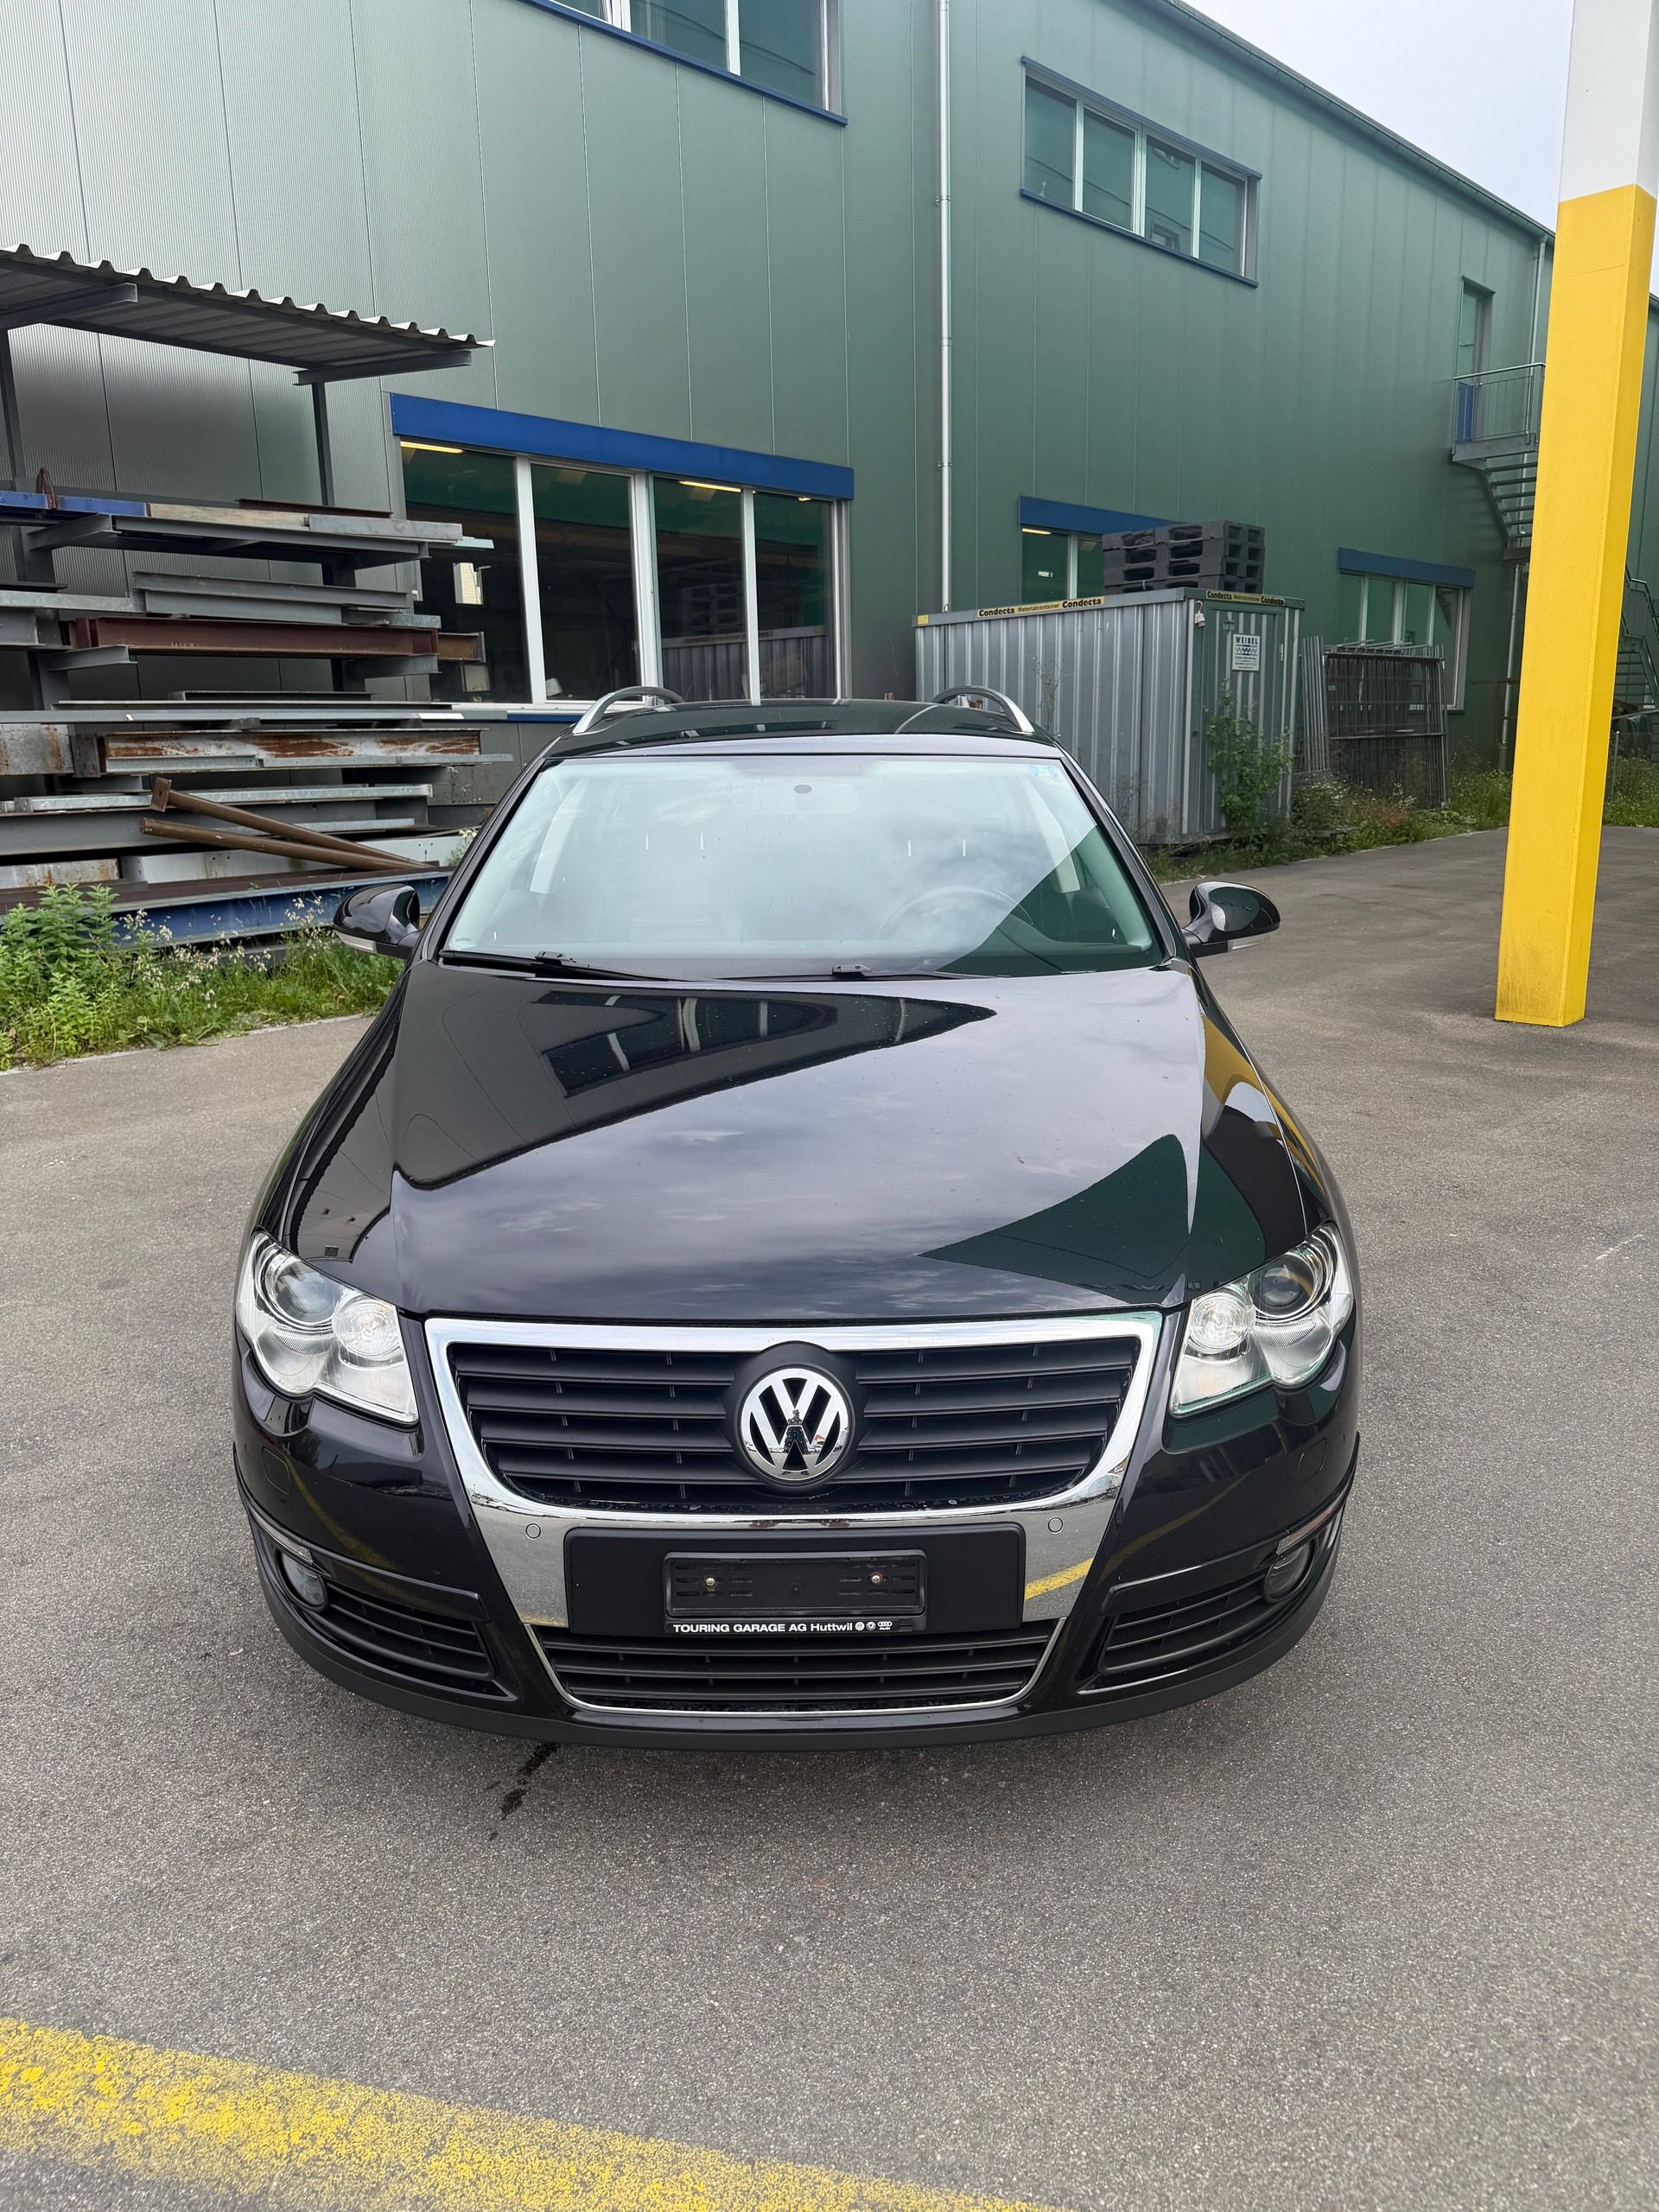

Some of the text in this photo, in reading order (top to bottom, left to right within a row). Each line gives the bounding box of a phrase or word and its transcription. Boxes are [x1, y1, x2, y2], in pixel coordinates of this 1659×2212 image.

[1207, 591, 1232, 601] Condecta
[1261, 596, 1285, 606] Condecta
[979, 597, 1102, 617] Condecta Materialcontainer Condecta
[673, 1624, 730, 1633] TOURING
[734, 1624, 785, 1633] GARAGE
[788, 1623, 807, 1632] AG
[810, 1622, 853, 1632] Huttwil
